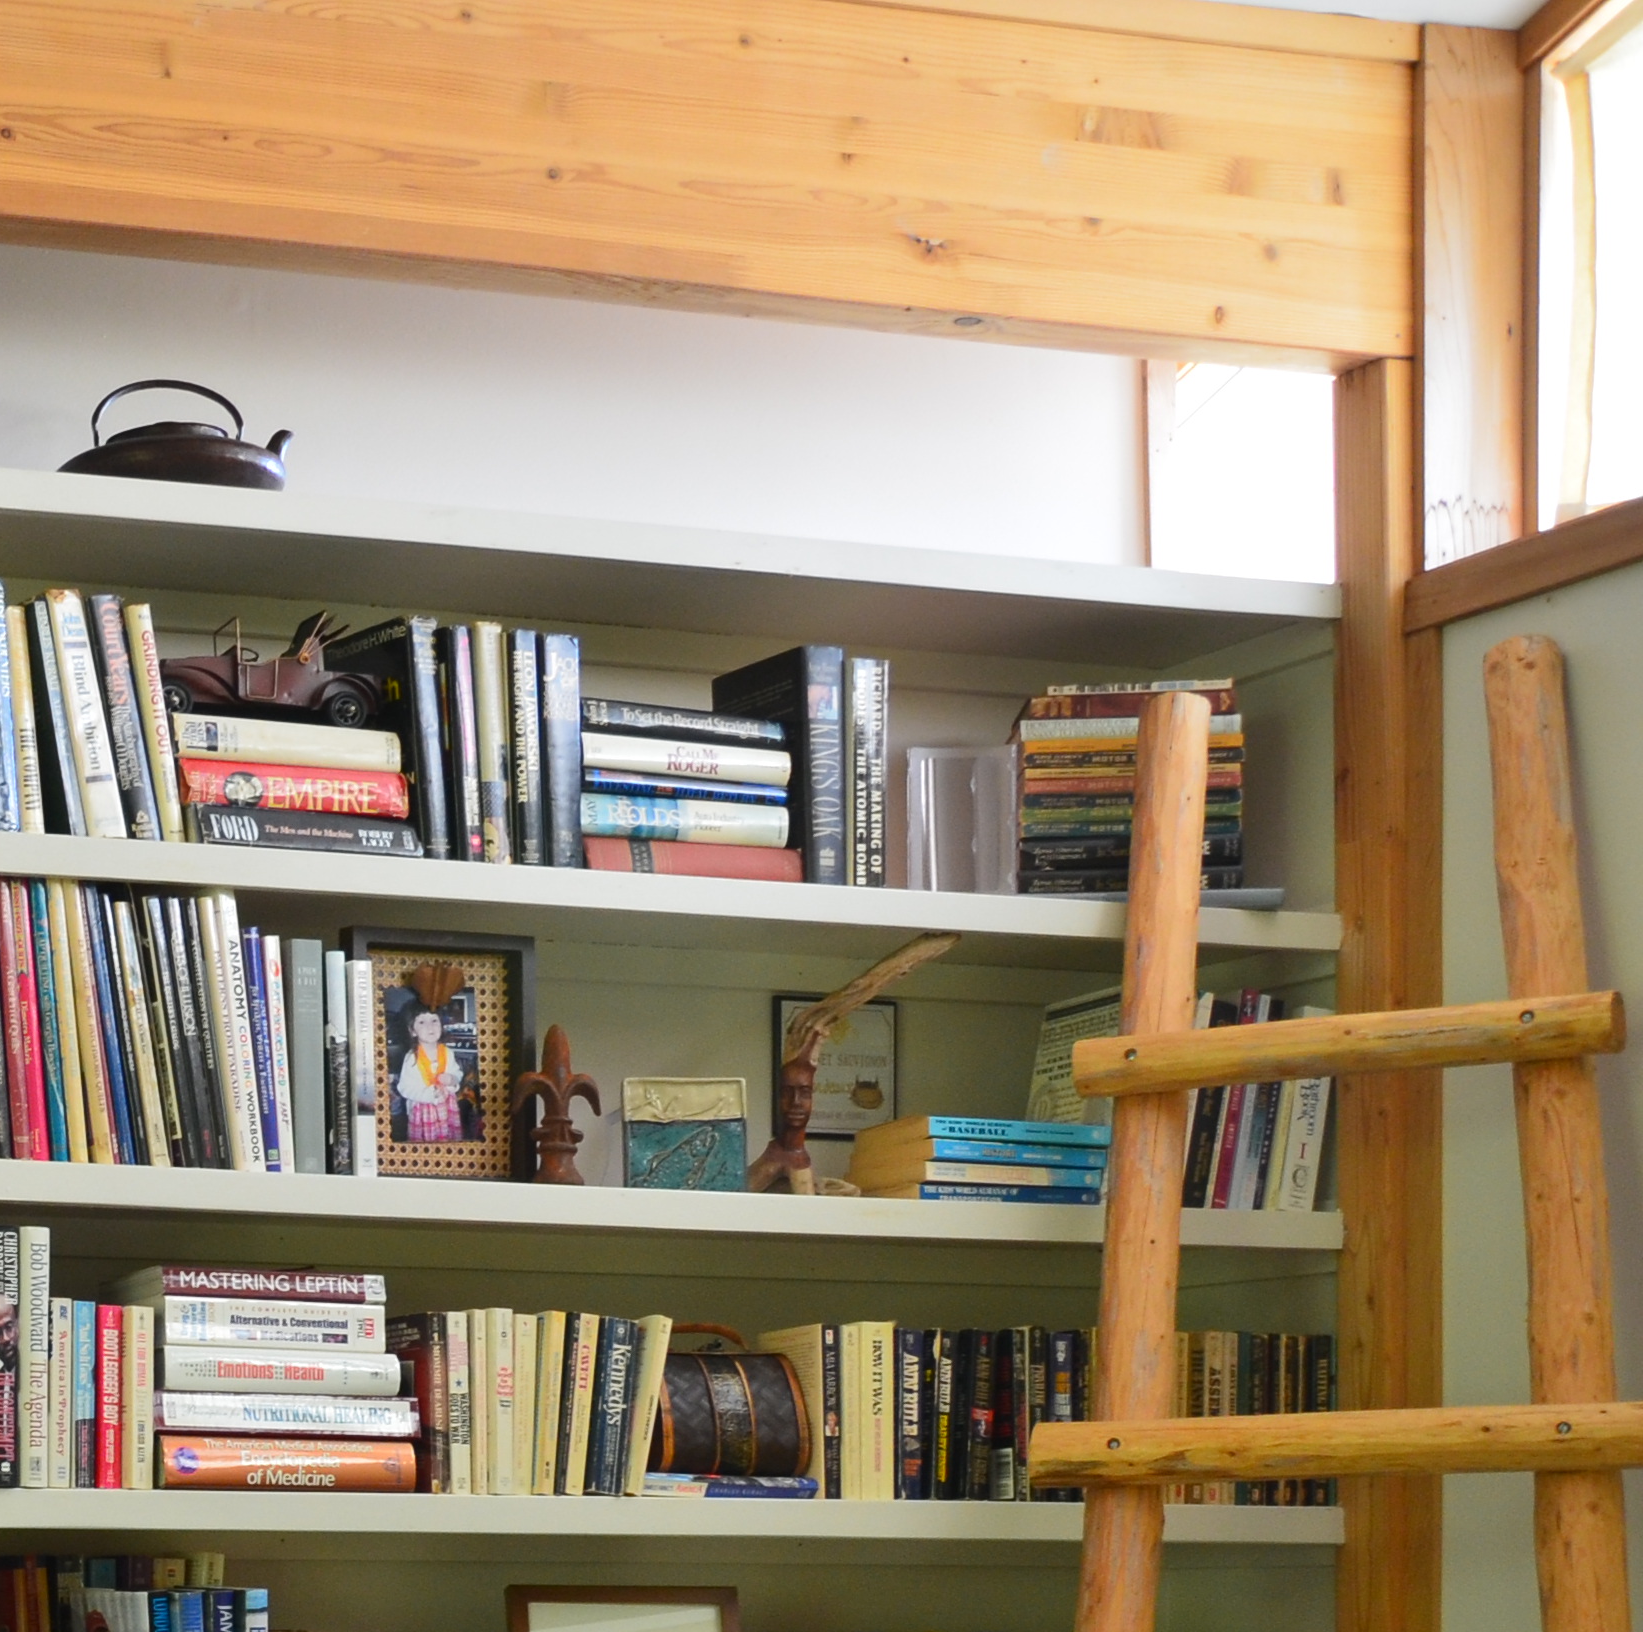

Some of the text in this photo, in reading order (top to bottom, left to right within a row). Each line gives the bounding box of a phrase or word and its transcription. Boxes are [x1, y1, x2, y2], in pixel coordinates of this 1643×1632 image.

[141, 630, 170, 756] GRINDING IT OUT
[267, 775, 379, 814] EMPIRE
[811, 722, 840, 840] KING'S OAK
[856, 750, 867, 886] THE ATOMIC BOMB
[870, 759, 881, 873] THE MAKING OF
[228, 940, 262, 1163] ANATOMY COLORING WORKBOOK
[29, 1243, 48, 1352] Bob Woodward
[180, 1271, 360, 1293] MASTERING LEPTIN
[28, 1360, 48, 1447] The Agenda
